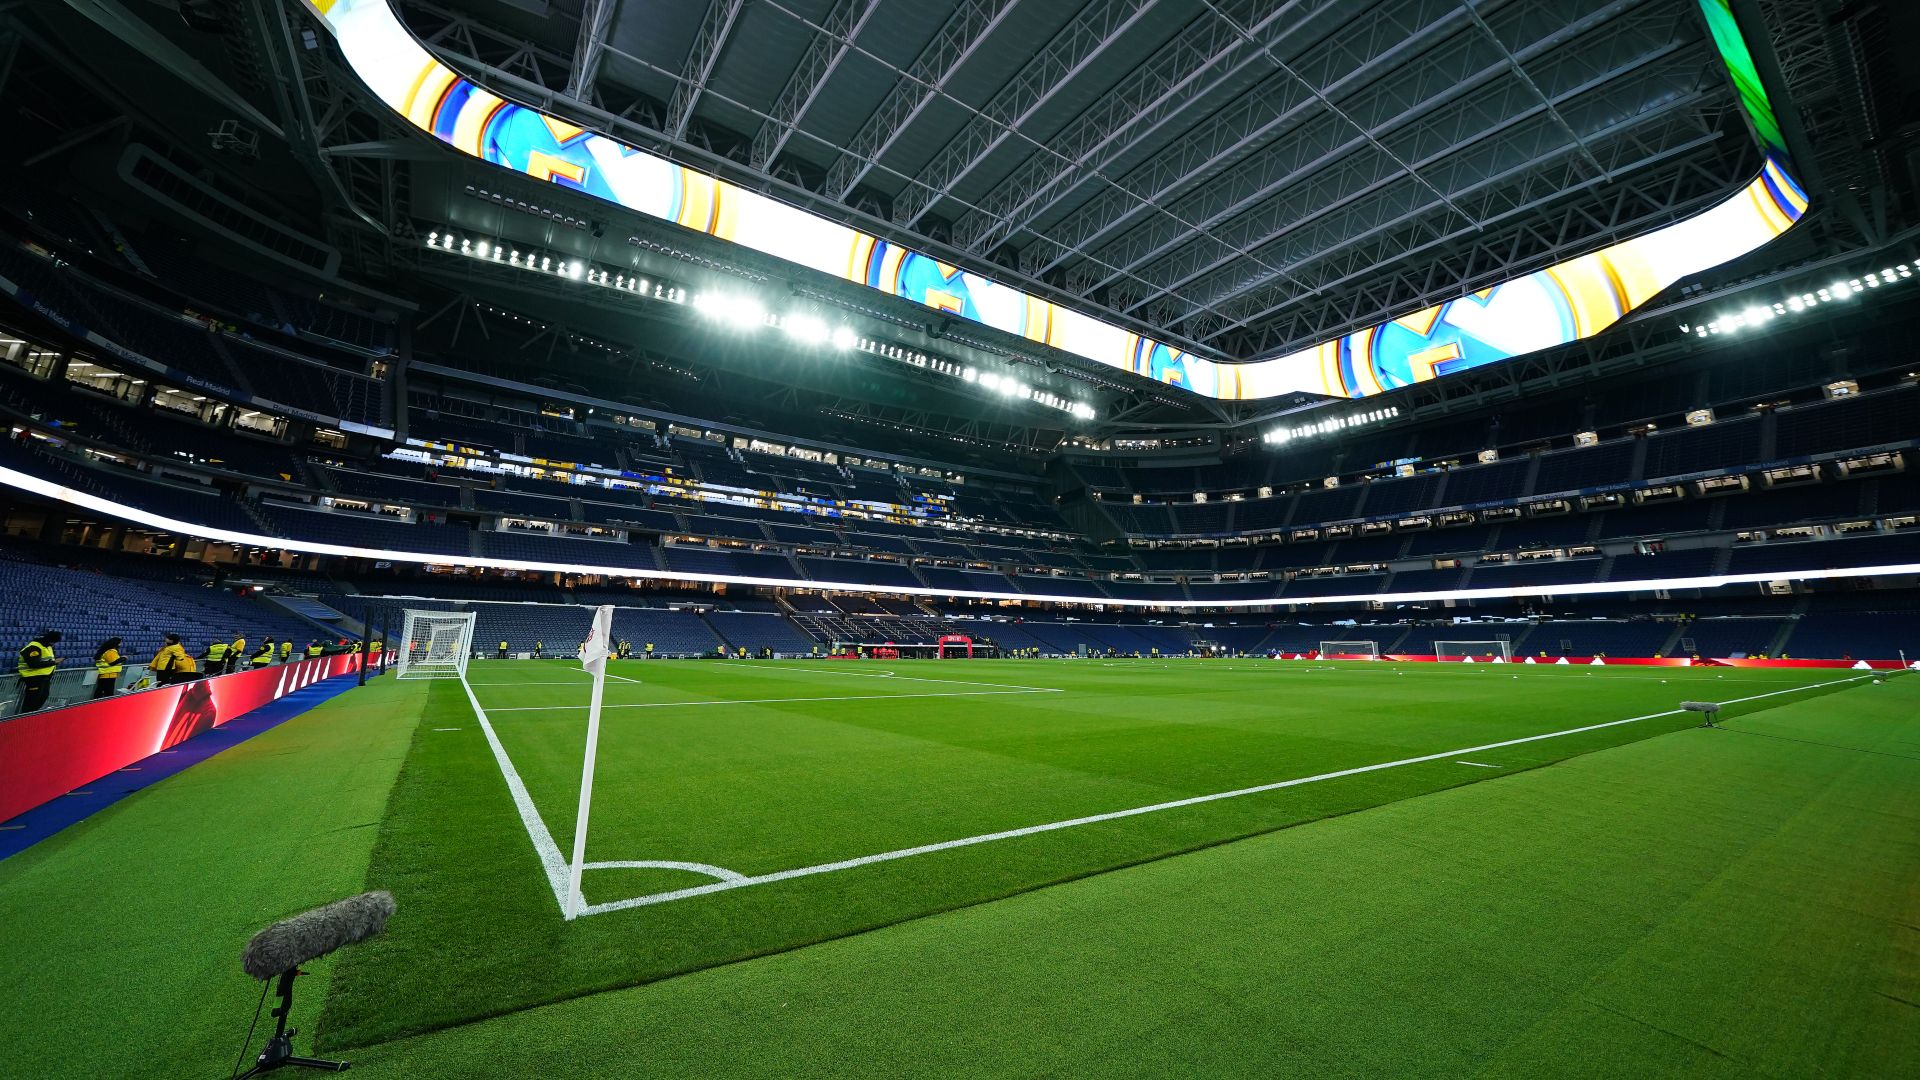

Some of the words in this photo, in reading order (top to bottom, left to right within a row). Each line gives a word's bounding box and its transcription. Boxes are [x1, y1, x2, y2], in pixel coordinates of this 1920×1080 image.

[33, 300, 49, 316] Real
[49, 309, 70, 328] Madrid
[105, 342, 120, 355] Real
[120, 349, 147, 366] Madrid
[185, 375, 204, 387] Real
[205, 380, 231, 395] Madrid
[273, 403, 290, 414] Real
[291, 408, 318, 421] Madrid
